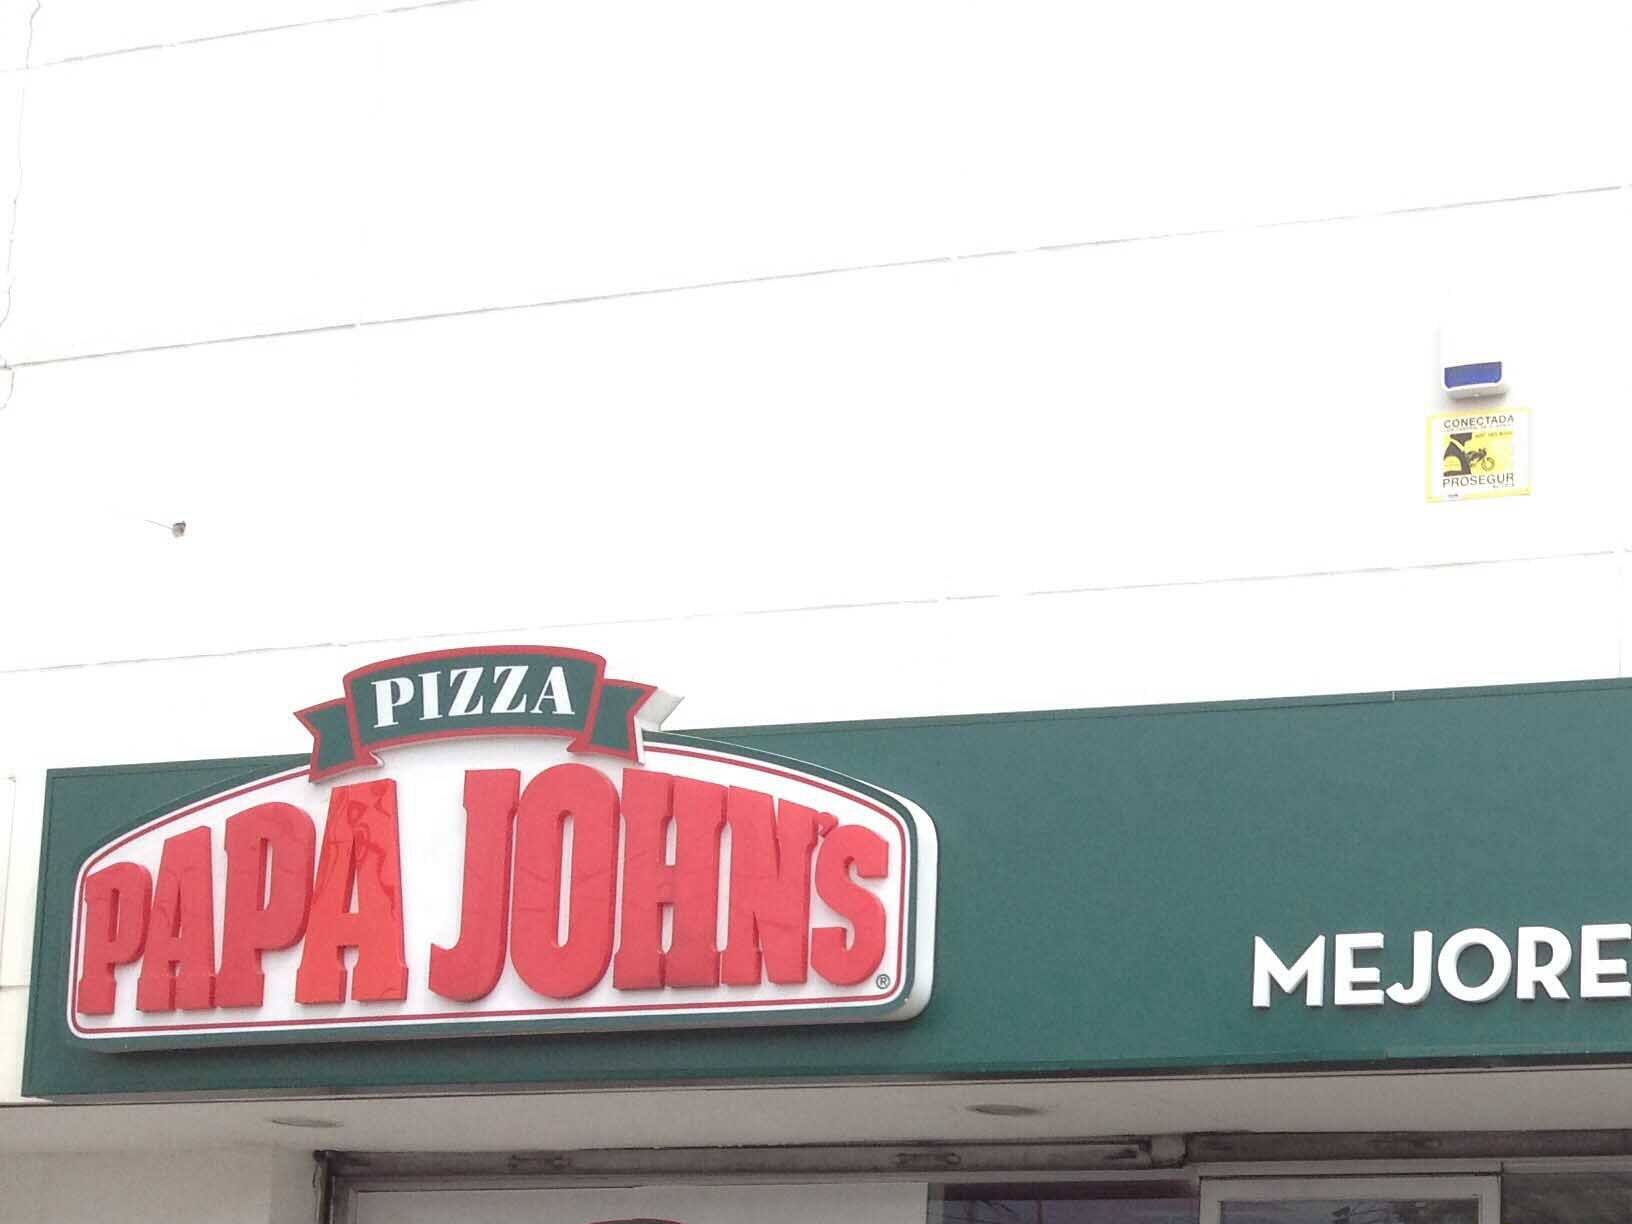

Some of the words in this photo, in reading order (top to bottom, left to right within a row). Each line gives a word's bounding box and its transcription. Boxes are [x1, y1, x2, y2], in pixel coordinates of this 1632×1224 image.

[1443, 415, 1514, 429] CONECTADA
[1442, 472, 1514, 488] PROSEGUR
[371, 664, 576, 729] PIZZA
[77, 777, 409, 1016] PAPA
